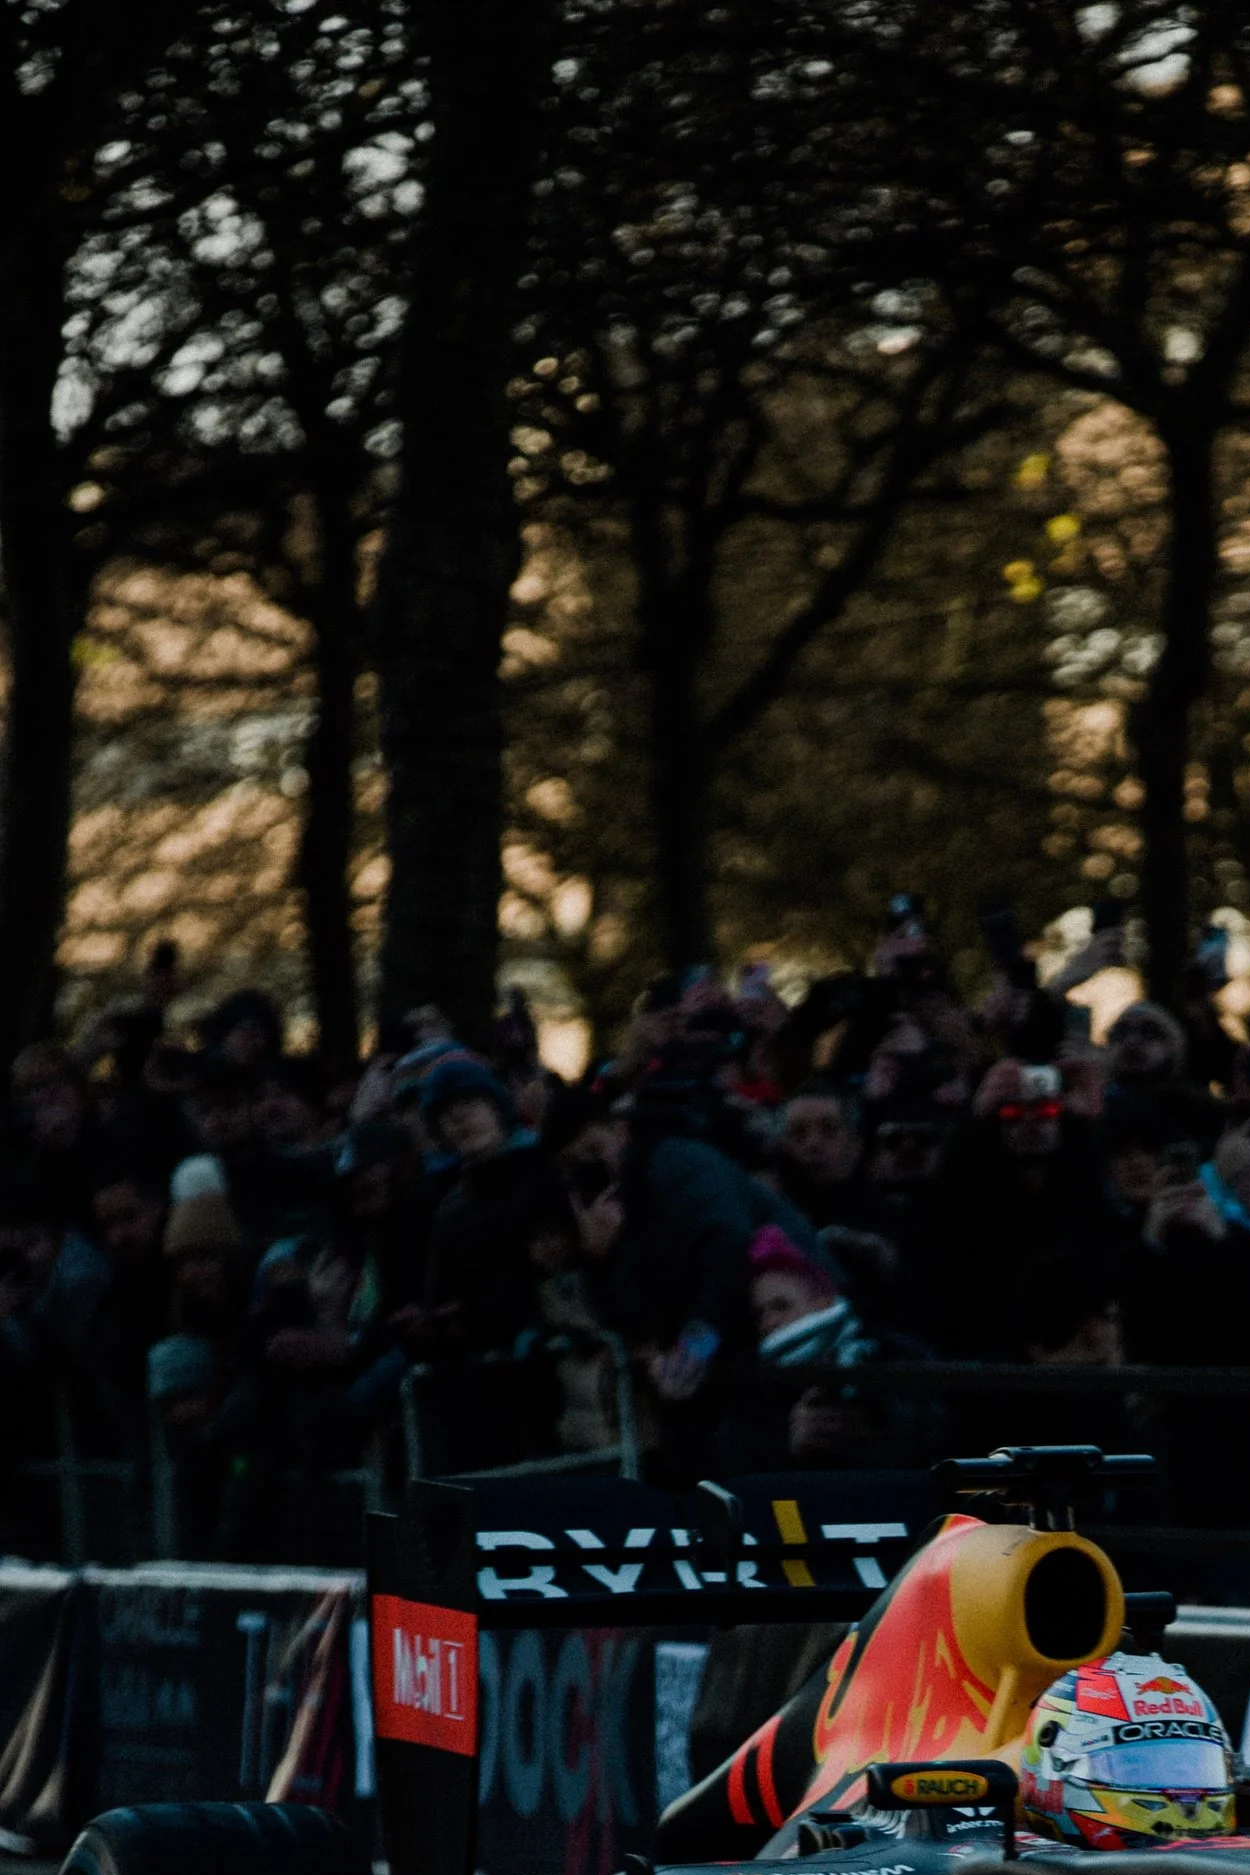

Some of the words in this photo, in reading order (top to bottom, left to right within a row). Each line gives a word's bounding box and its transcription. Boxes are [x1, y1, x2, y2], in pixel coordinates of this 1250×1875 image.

[1134, 1700, 1171, 1716] Red
[1175, 1698, 1204, 1718] Bull
[1117, 1721, 1223, 1743] ORACLE
[917, 1777, 978, 1795] RAUCH
